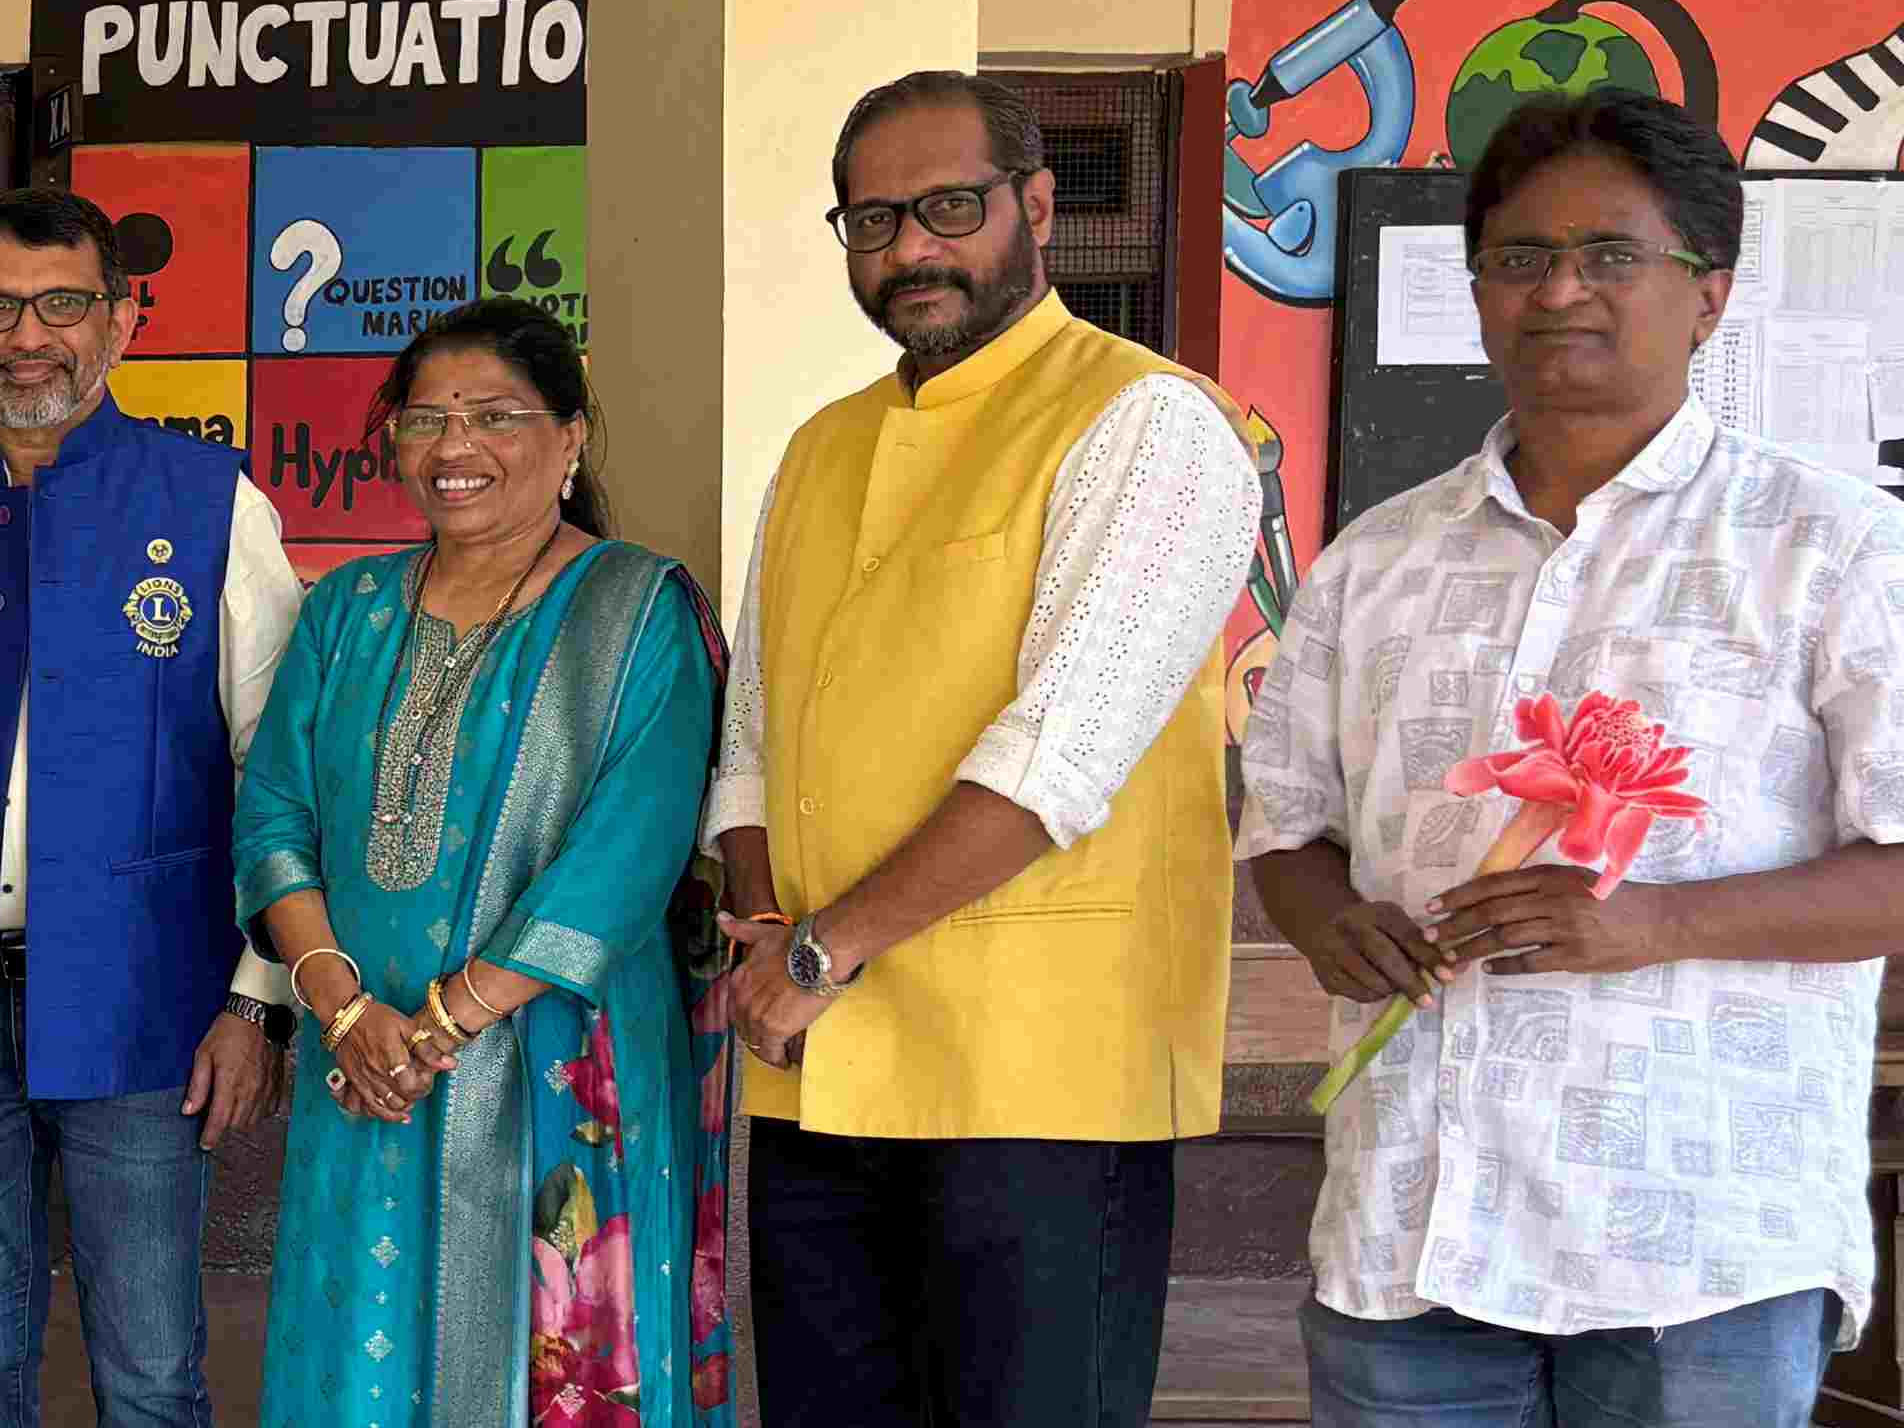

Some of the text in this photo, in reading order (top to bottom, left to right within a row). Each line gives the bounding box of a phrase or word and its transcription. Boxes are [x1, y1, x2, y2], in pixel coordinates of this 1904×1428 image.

[323, 275, 466, 306] QUESTION
[152, 596, 172, 621] L
[136, 641, 179, 658] INDIA
